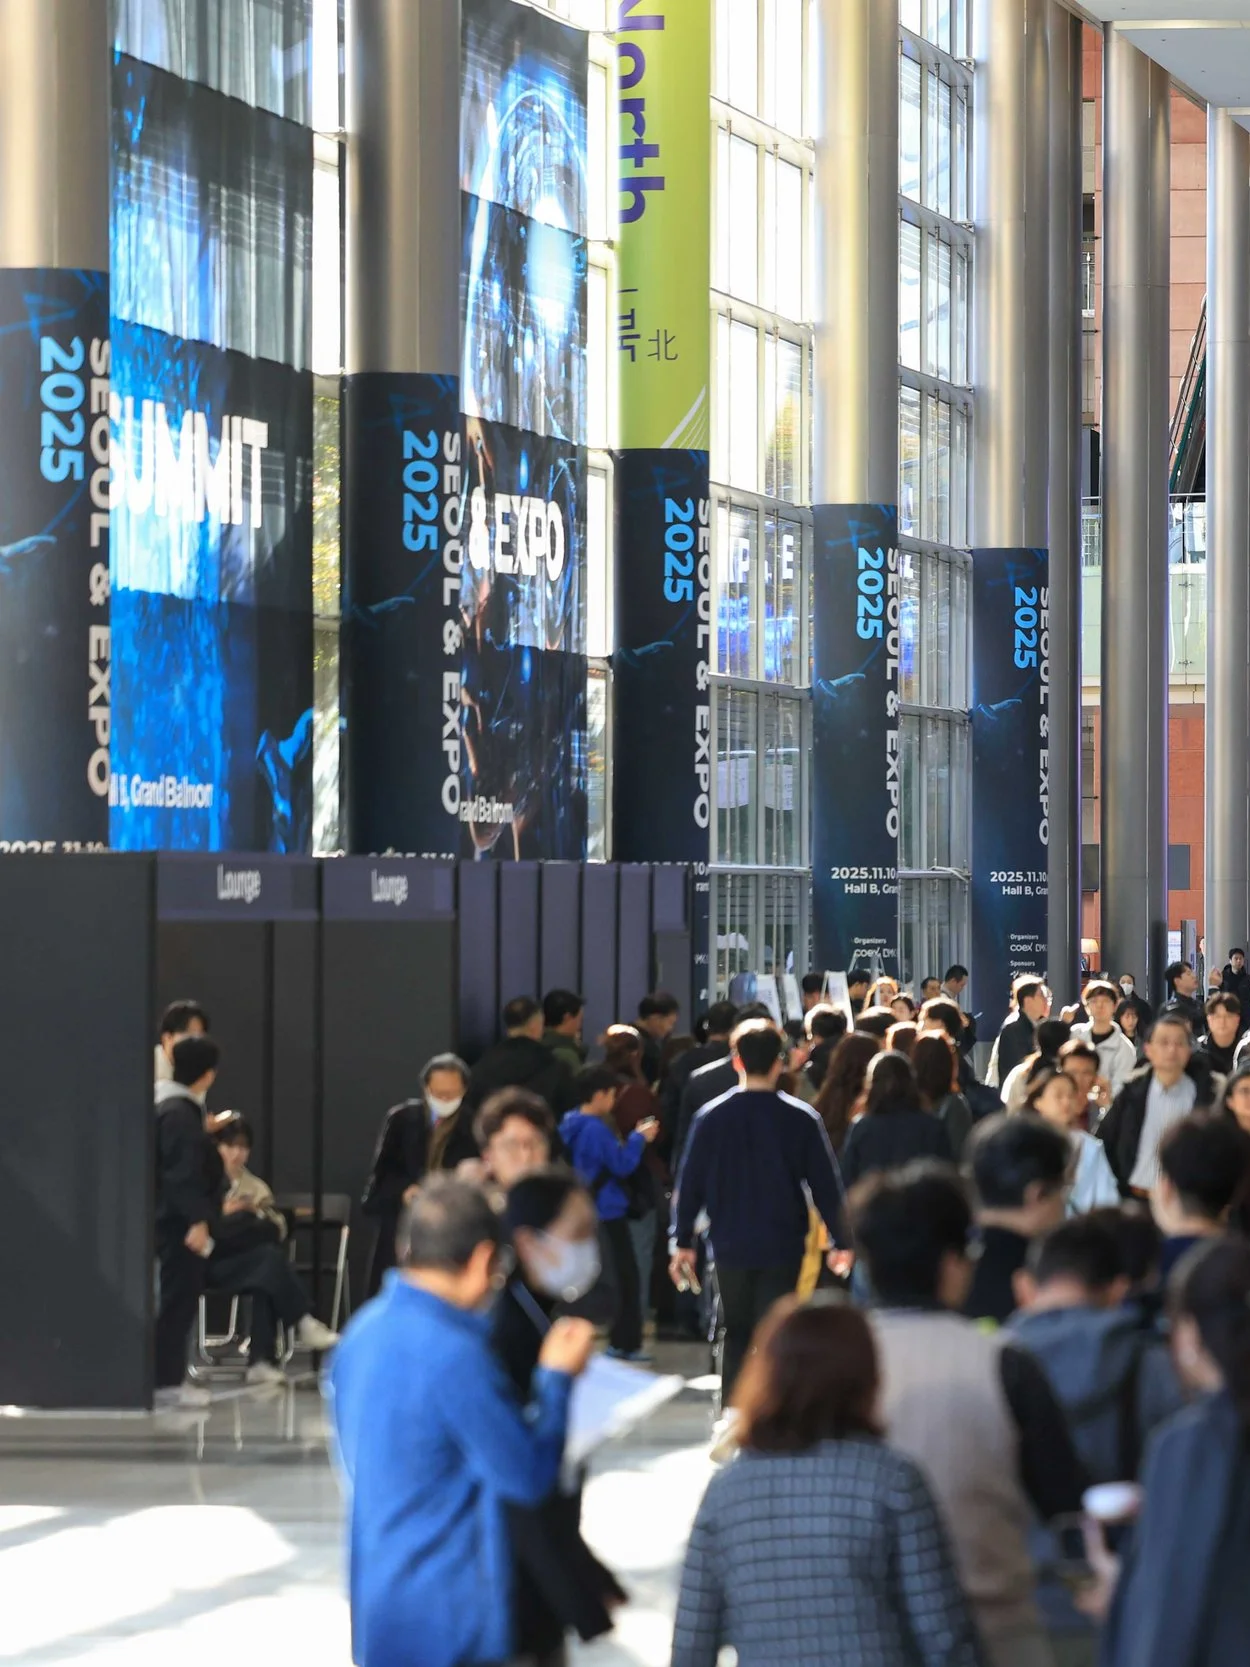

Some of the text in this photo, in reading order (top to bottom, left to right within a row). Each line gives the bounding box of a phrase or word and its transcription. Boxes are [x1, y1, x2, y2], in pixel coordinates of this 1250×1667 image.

[617, 0, 664, 224] North
[647, 329, 678, 361] 北
[40, 336, 85, 483] 2025
[402, 430, 439, 551] 2025
[468, 486, 565, 582] & EXPO
[663, 497, 695, 603] 2025
[856, 547, 885, 640] 2025
[1013, 586, 1038, 670] 2025
[217, 863, 262, 904] Lounge
[371, 868, 409, 906] Lounge
[844, 883, 868, 895] Hall
[869, 883, 881, 896] B,
[1002, 886, 1022, 896] Hall
[1025, 886, 1034, 897] B,
